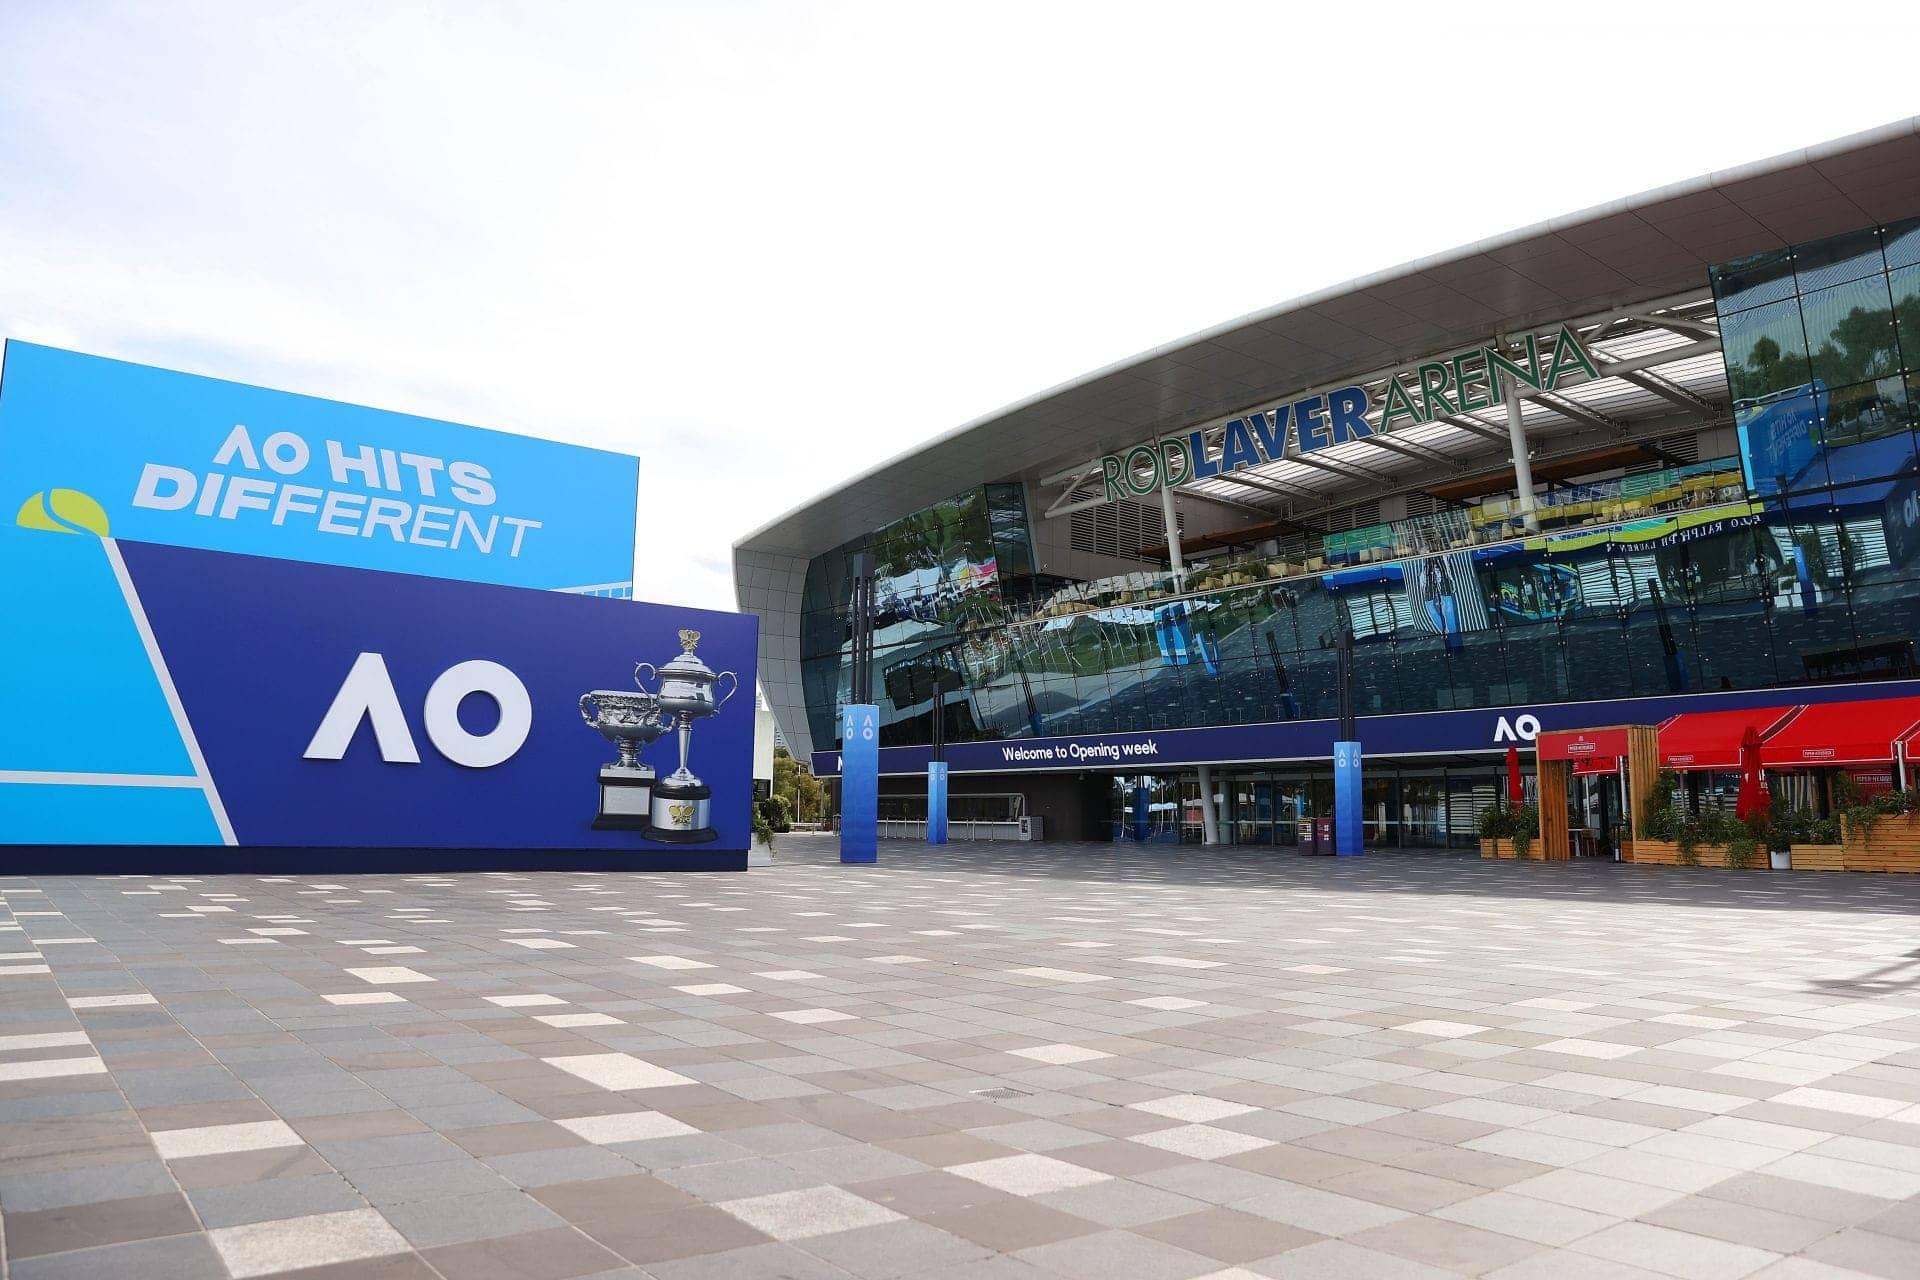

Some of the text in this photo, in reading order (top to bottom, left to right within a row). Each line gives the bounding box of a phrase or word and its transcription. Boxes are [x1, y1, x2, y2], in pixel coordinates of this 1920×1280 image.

[1102, 322, 1601, 503] ROD LAVER ARENA
[132, 462, 542, 557] DIFFERENT
[212, 424, 498, 506] AO HITS
[303, 652, 532, 768] AO
[1002, 739, 1158, 762] Welcome to Opening week
